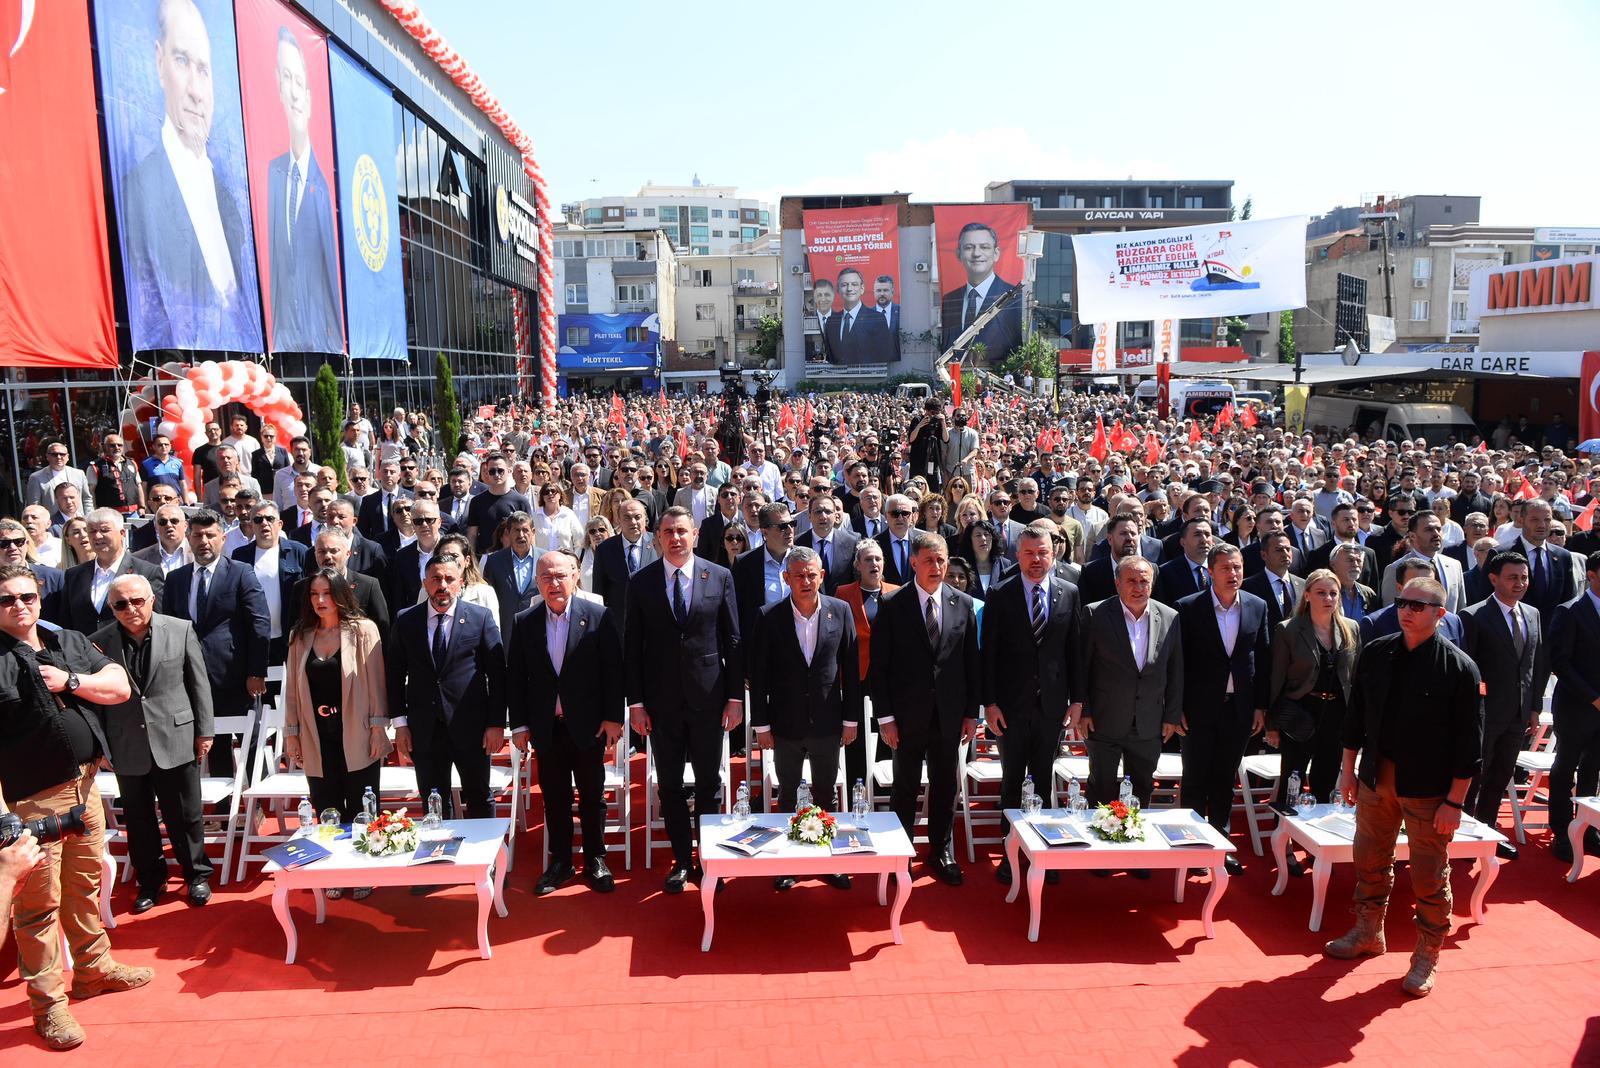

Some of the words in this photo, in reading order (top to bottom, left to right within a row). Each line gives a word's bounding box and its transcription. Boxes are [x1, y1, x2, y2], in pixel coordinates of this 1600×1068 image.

[1139, 211, 1164, 219] YAPI
[814, 236, 837, 244] BUCA
[838, 231, 884, 243] BELEDİYESİ
[808, 245, 834, 253] TOPLU
[836, 243, 862, 253] AÇILIŞ
[864, 240, 893, 250] TÖRENİ
[1117, 255, 1161, 266] HAREKET
[1172, 260, 1196, 270] HALK
[1488, 262, 1592, 310] MMM
[1441, 357, 1473, 370] CAR
[1481, 357, 1530, 371] CARE
